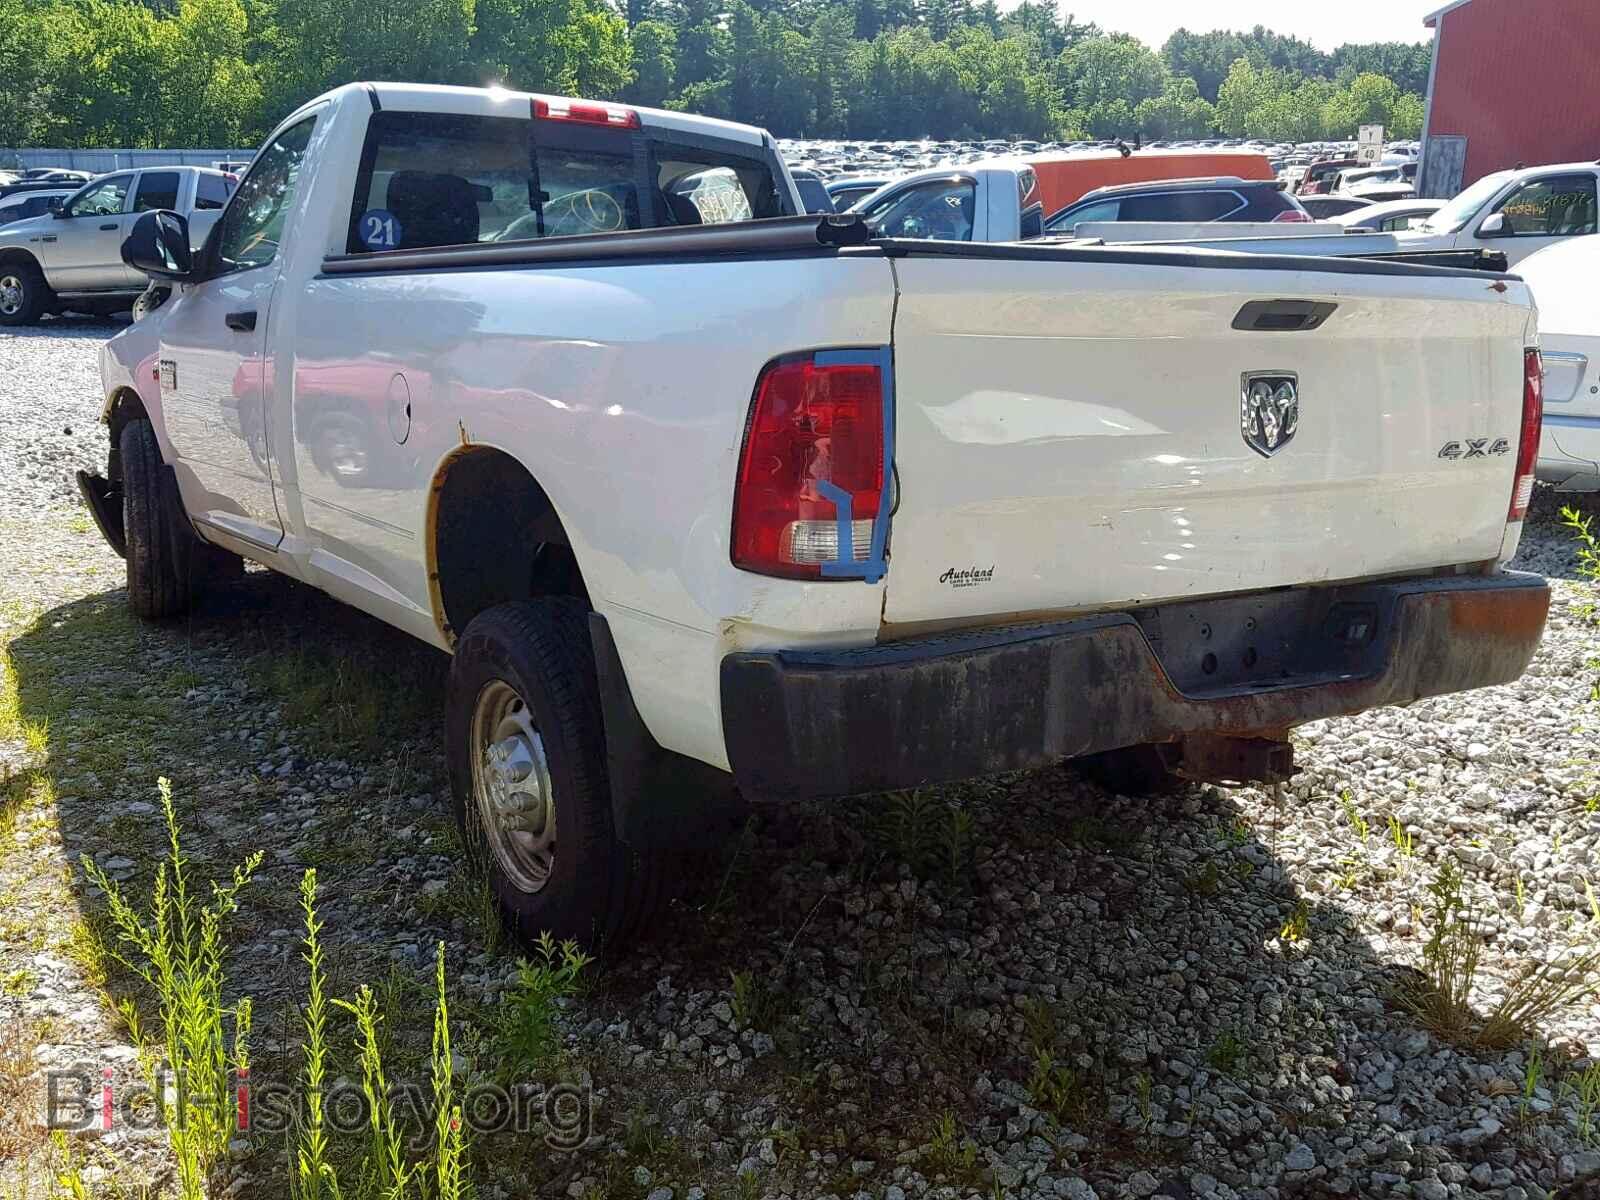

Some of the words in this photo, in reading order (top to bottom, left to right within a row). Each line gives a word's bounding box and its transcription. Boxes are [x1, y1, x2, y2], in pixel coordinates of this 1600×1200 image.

[1364, 149, 1375, 160] 40
[367, 216, 395, 246] 21
[939, 564, 995, 583] Autoland
